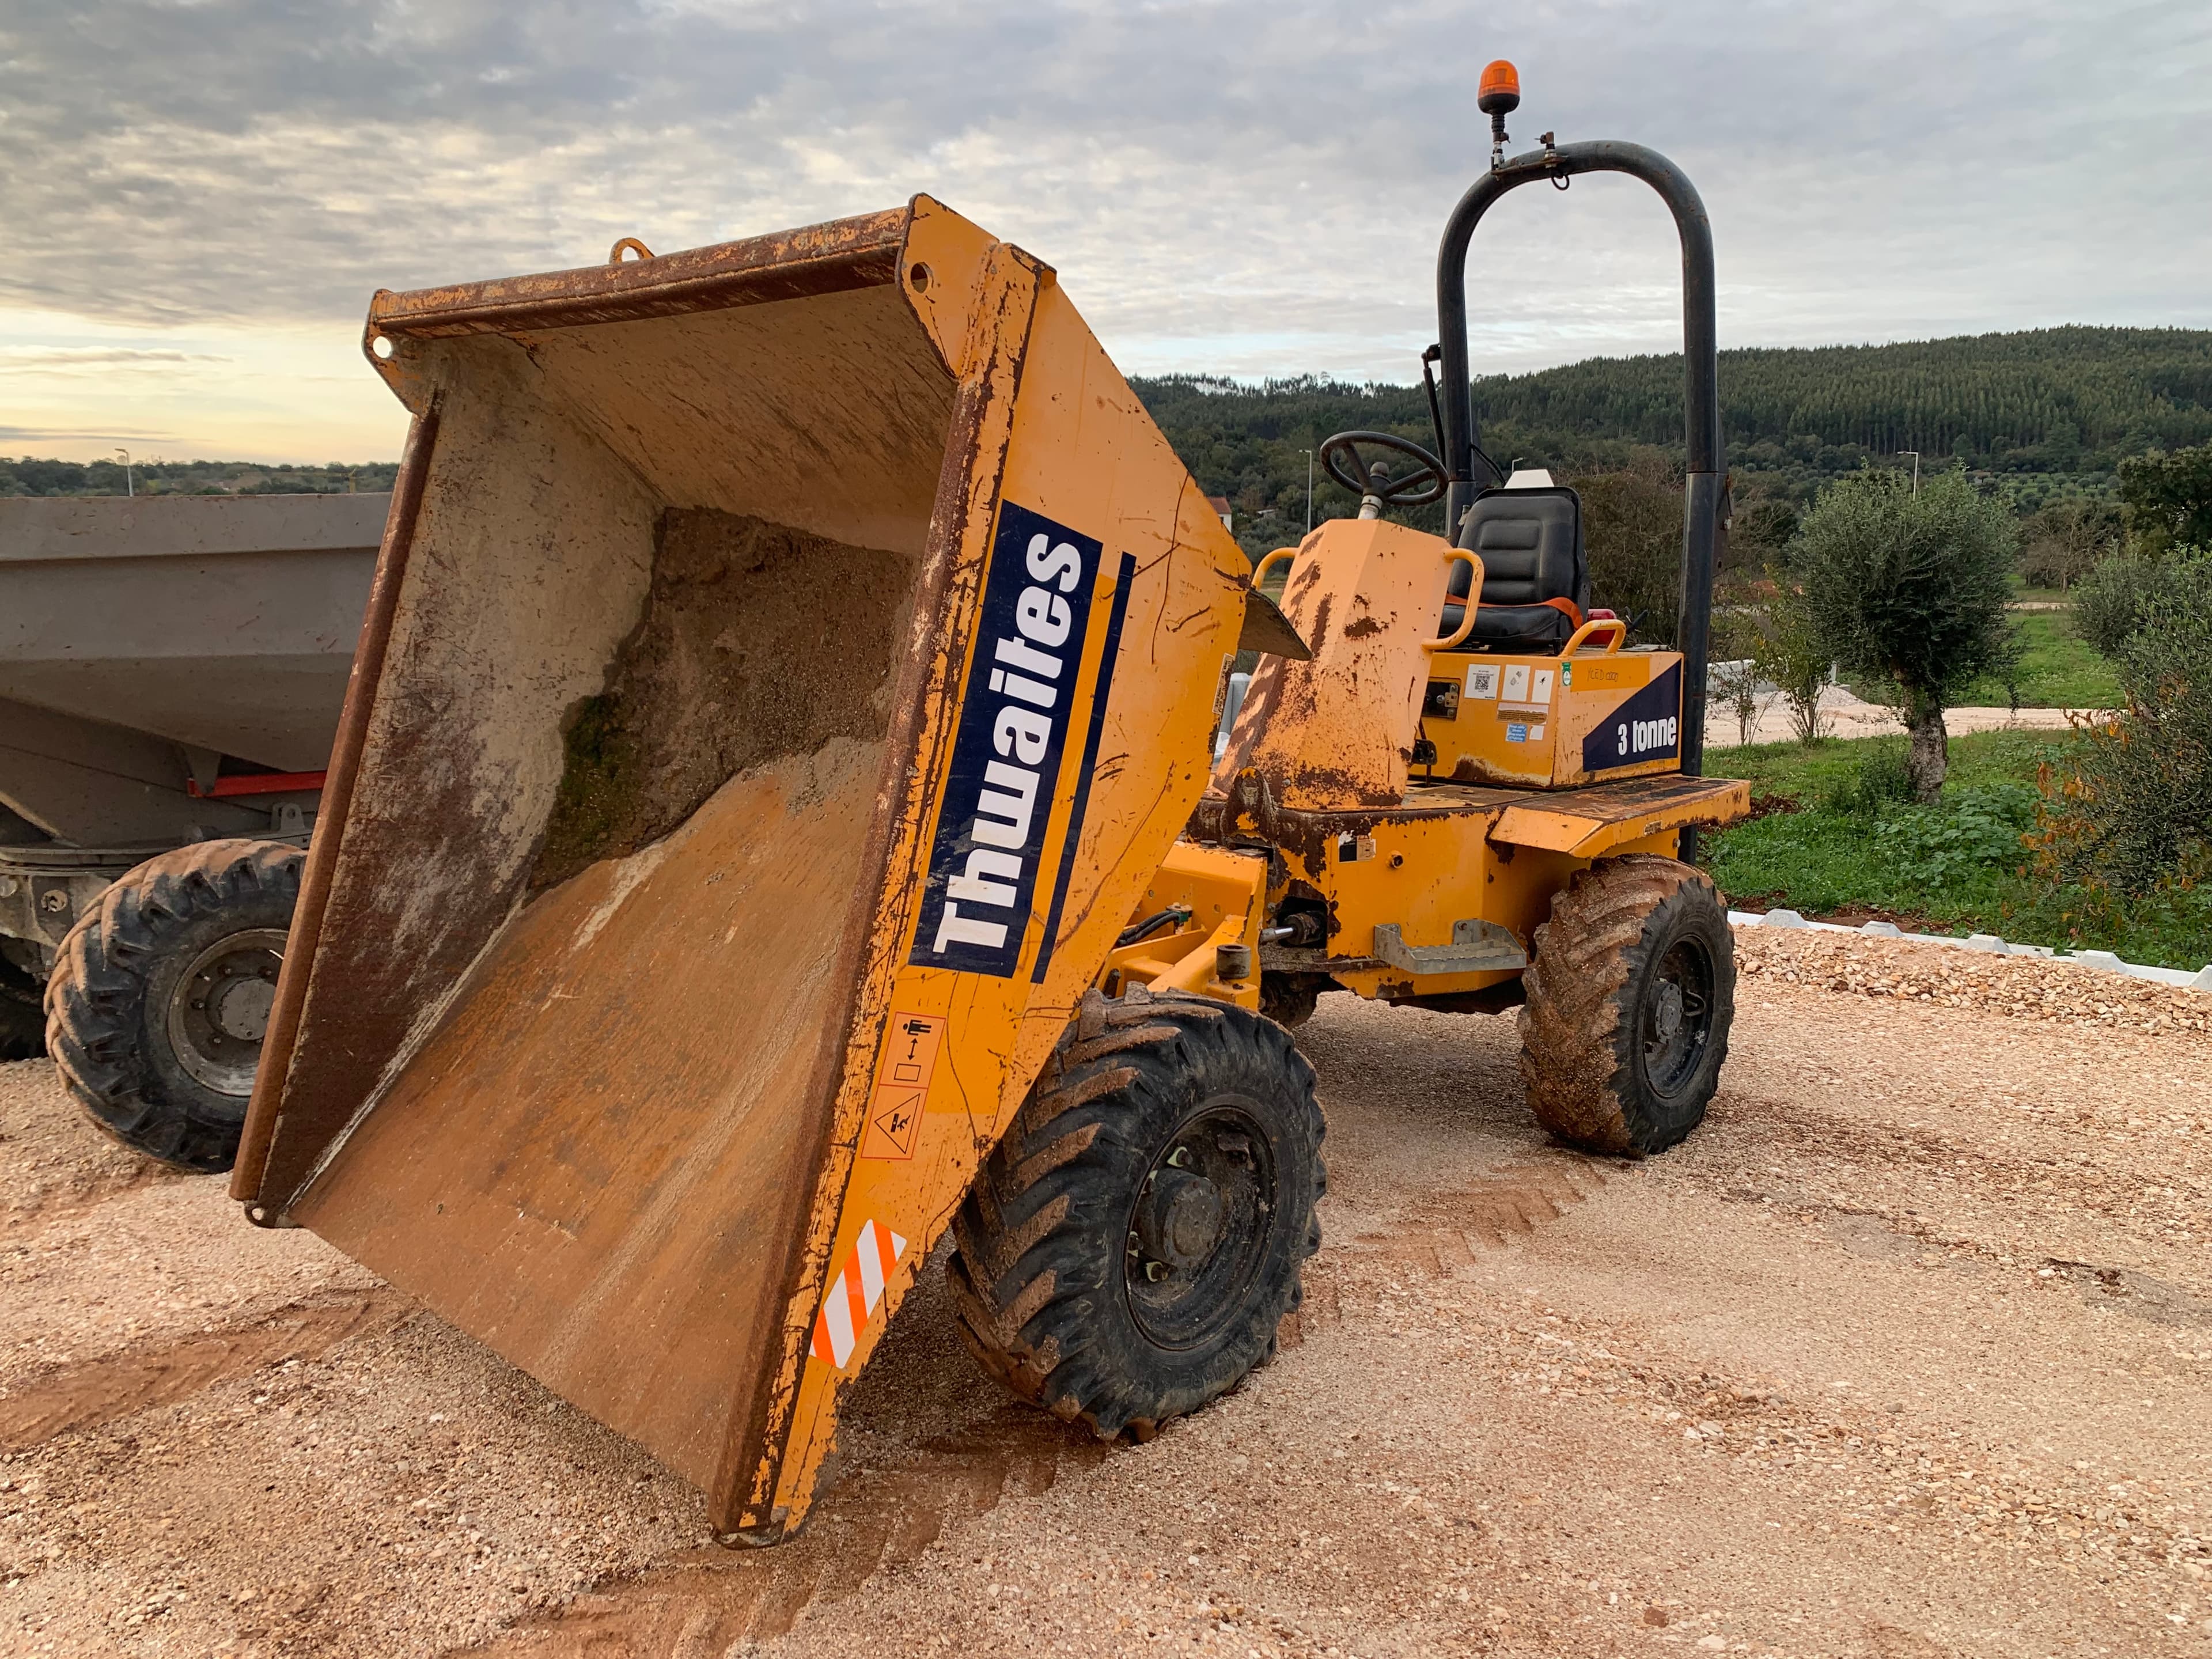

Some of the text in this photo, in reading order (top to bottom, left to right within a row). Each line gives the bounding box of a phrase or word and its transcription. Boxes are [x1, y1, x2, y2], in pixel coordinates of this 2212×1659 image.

[933, 533, 1081, 955] Thwaites
[1618, 715, 1677, 756] 3 tonne
